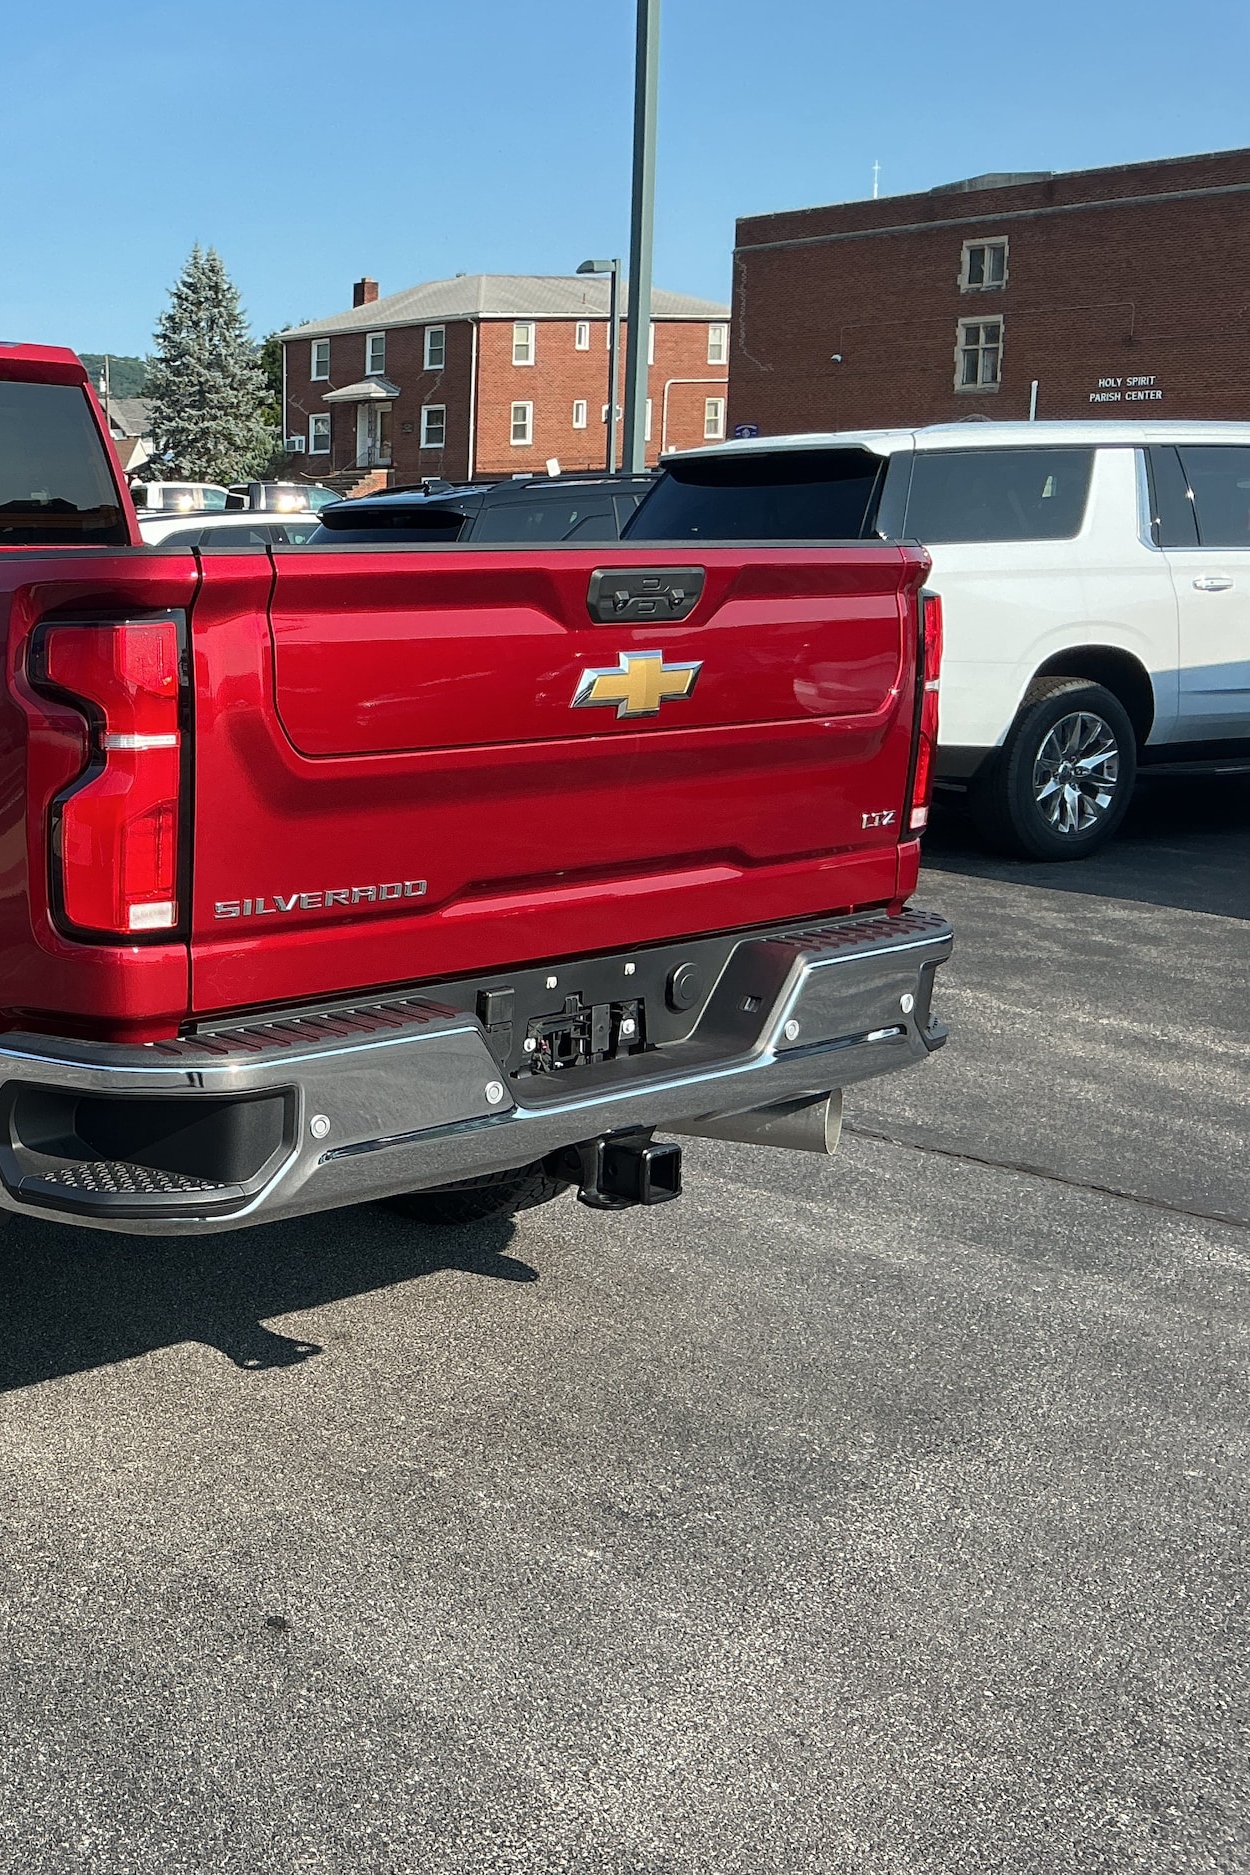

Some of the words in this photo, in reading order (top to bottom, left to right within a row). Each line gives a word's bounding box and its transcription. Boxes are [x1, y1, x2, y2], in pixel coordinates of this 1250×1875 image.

[1098, 378, 1122, 388] HOLY
[1126, 375, 1156, 387] SPIRIT
[1089, 392, 1121, 402] PARISH
[1125, 390, 1162, 400] CENTER
[862, 810, 896, 829] LTZ
[214, 879, 428, 919] SILVERADO
